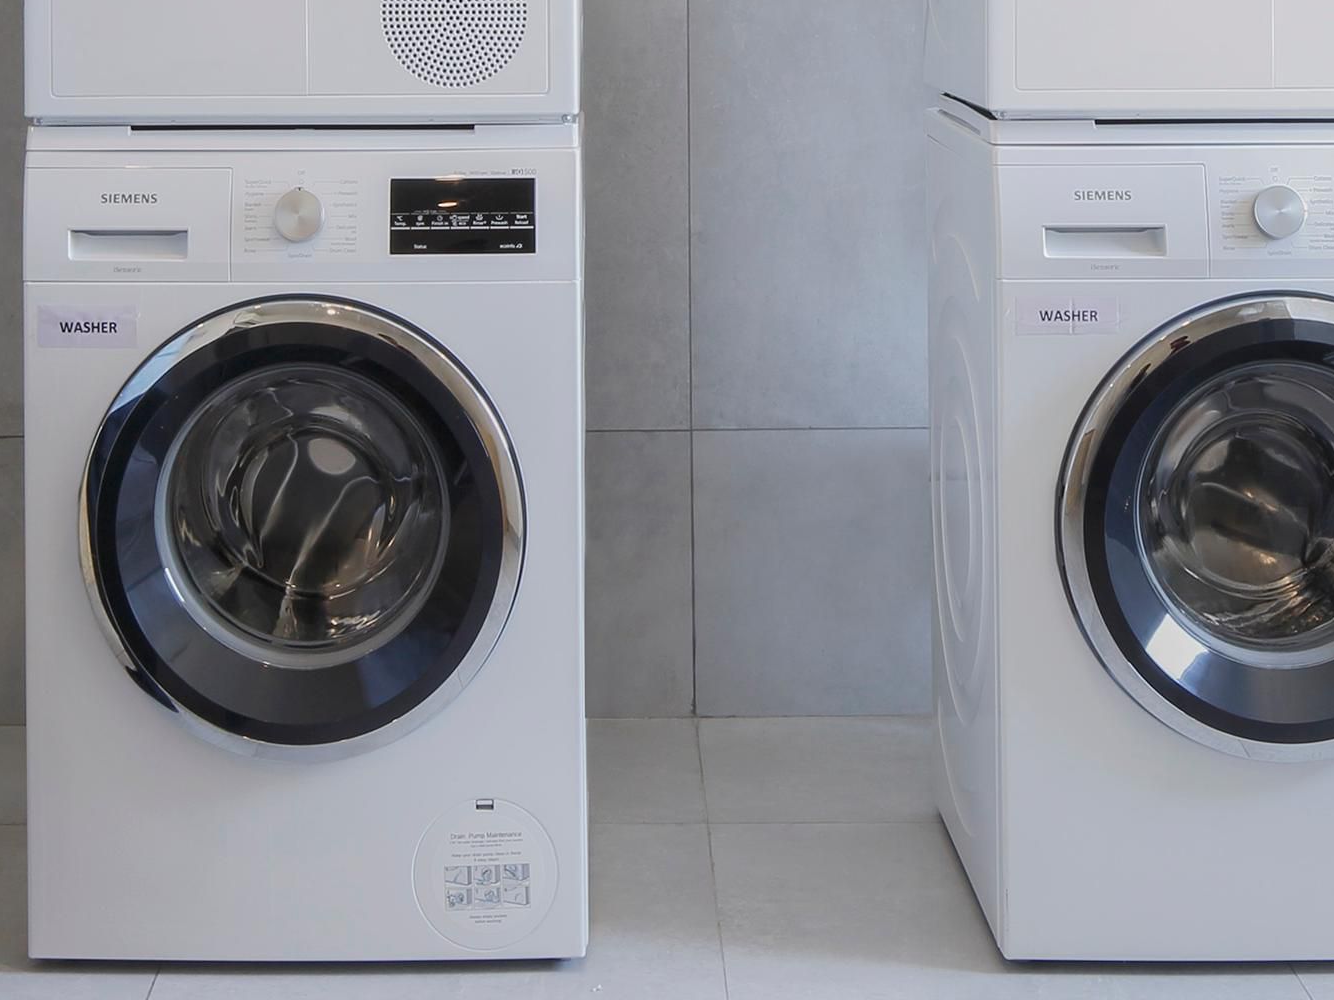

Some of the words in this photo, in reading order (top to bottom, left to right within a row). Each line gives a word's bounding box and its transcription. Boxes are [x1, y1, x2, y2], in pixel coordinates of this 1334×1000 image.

[101, 193, 157, 203] SIEMENS
[1074, 190, 1131, 201] SIEMENS
[1039, 310, 1098, 322] WASHER
[59, 322, 117, 333] WASHER
